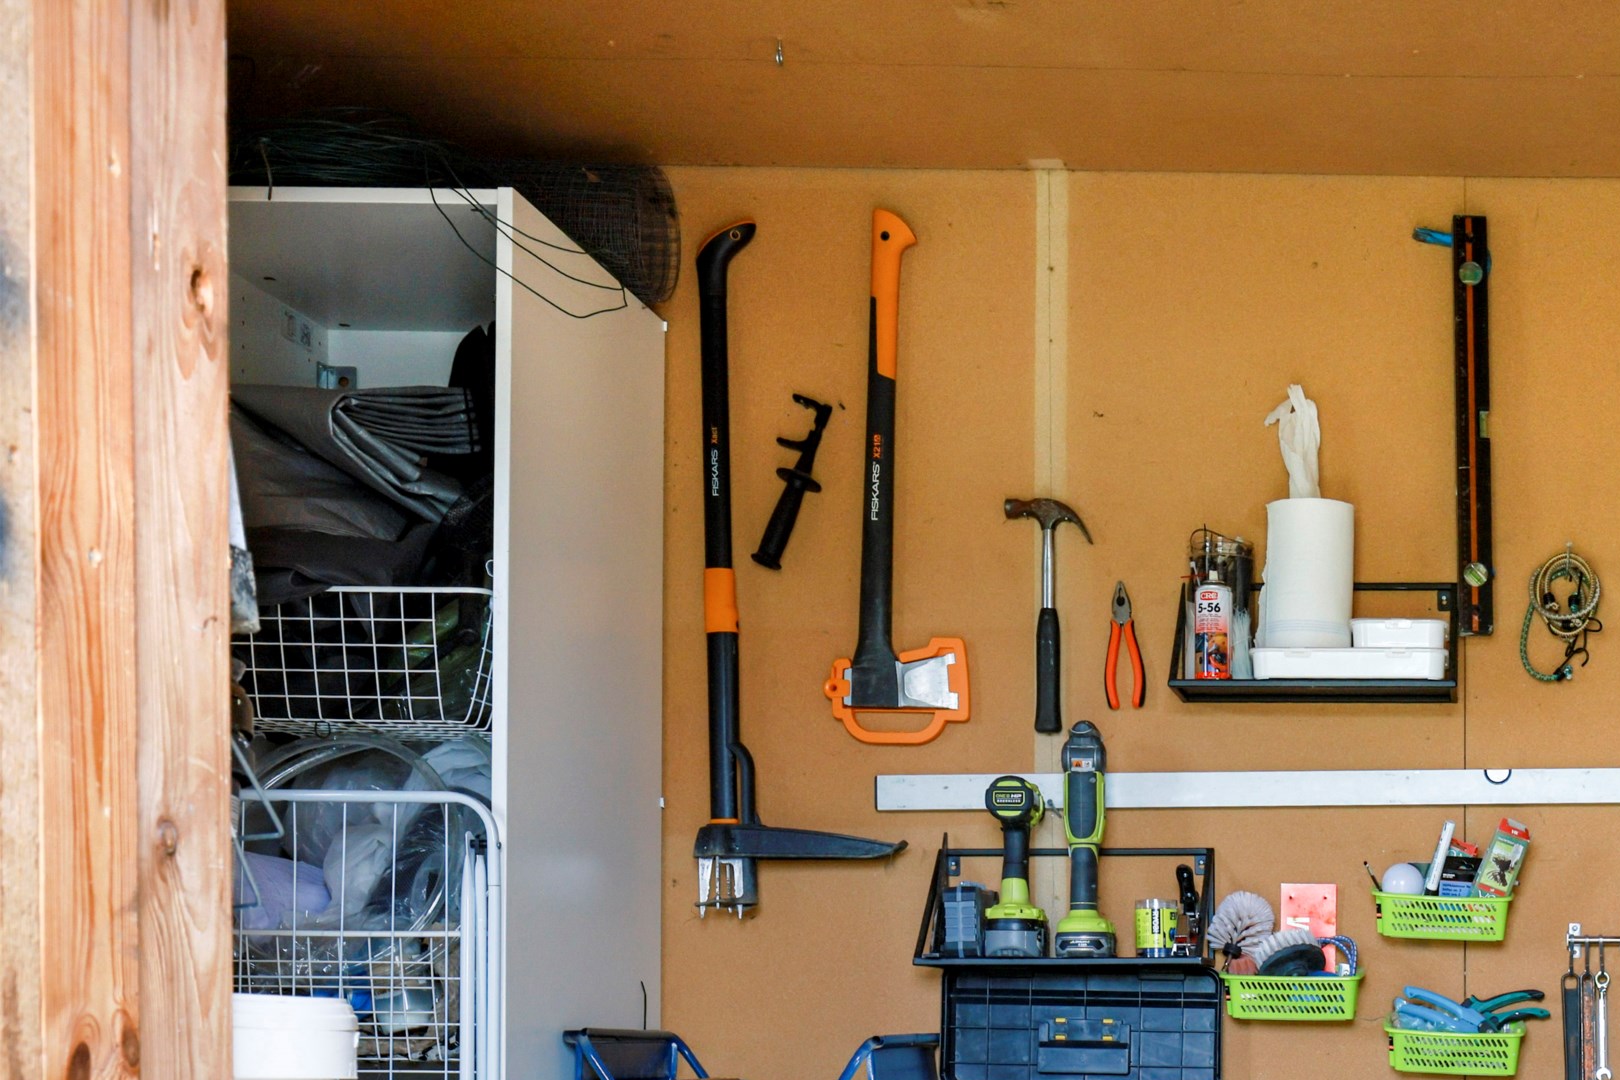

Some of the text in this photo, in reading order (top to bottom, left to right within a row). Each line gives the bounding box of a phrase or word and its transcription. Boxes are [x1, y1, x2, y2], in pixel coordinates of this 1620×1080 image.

[711, 450, 719, 496] FISKARS
[871, 463, 880, 520] FISKARS
[1197, 602, 1221, 613] 5-56
